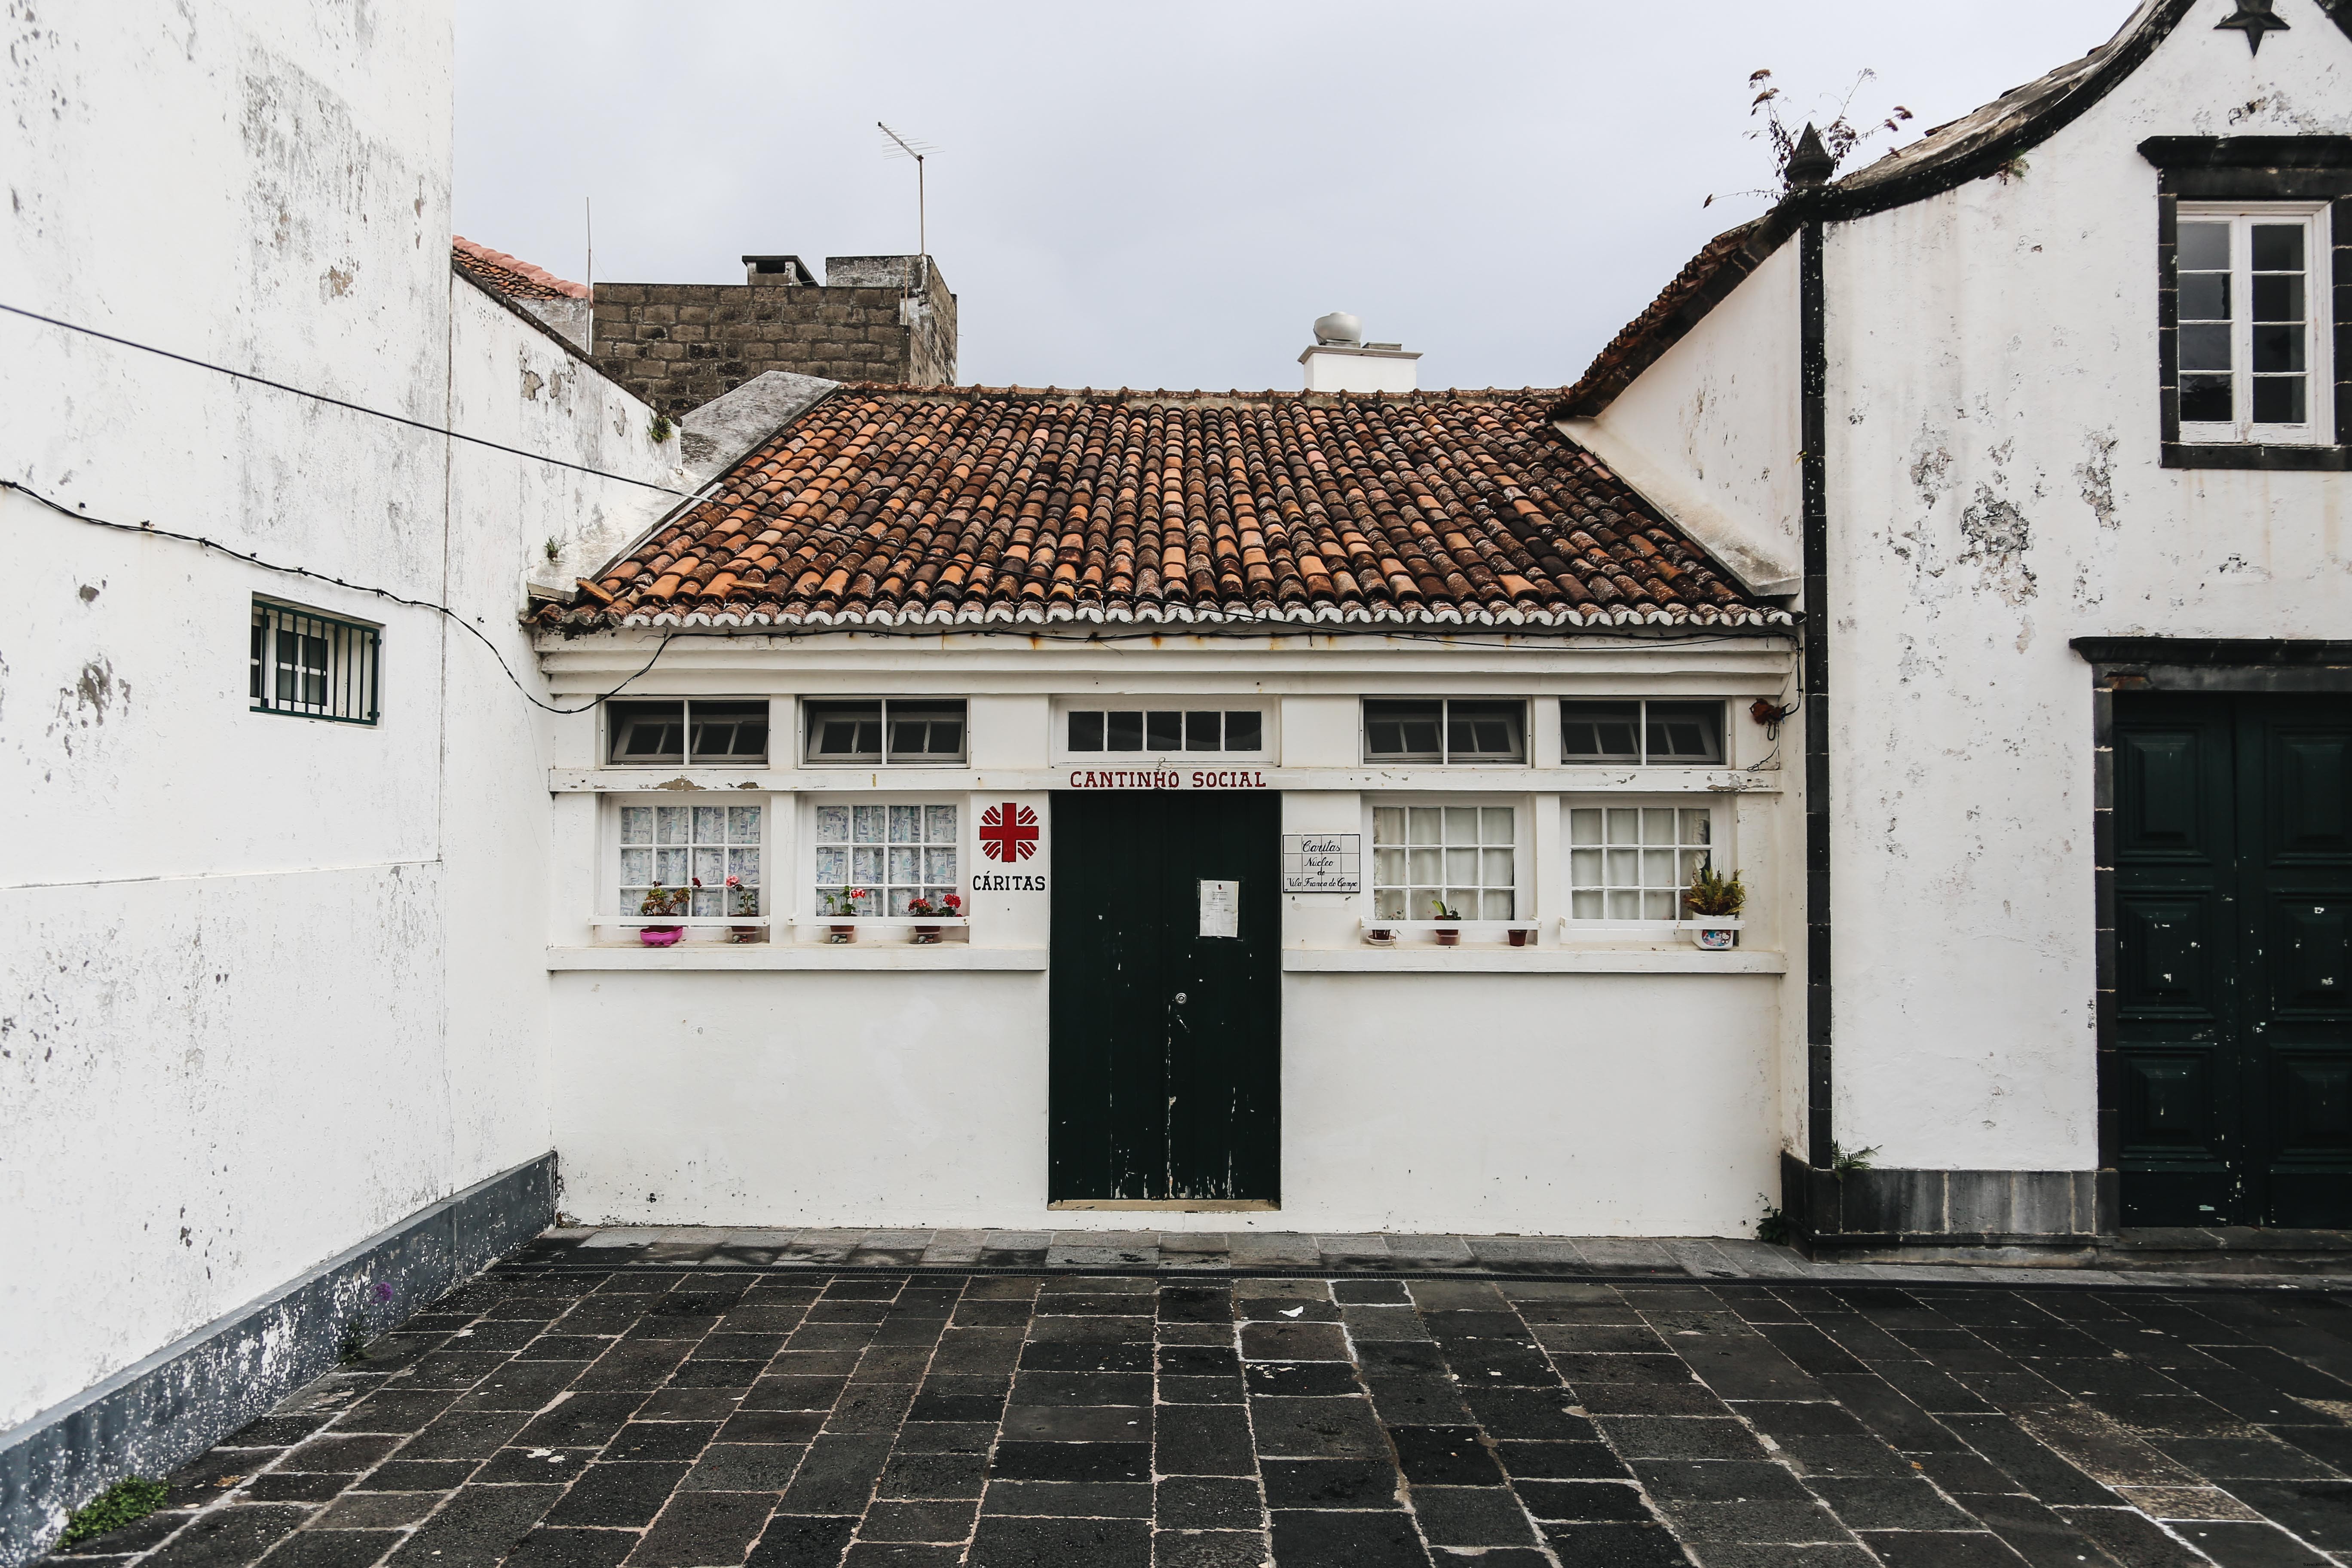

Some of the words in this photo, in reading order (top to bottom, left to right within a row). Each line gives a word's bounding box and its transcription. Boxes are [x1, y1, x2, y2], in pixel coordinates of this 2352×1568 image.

[1070, 771, 1179, 787] CANTINHO
[1192, 772, 1266, 787] SOCIAL
[1317, 866, 1325, 876] de
[973, 871, 1045, 891] CÁRITAS
[1287, 878, 1302, 887] Vila
[1303, 877, 1328, 887] Franca
[1329, 878, 1336, 887] do
[1337, 877, 1358, 891] Campo
